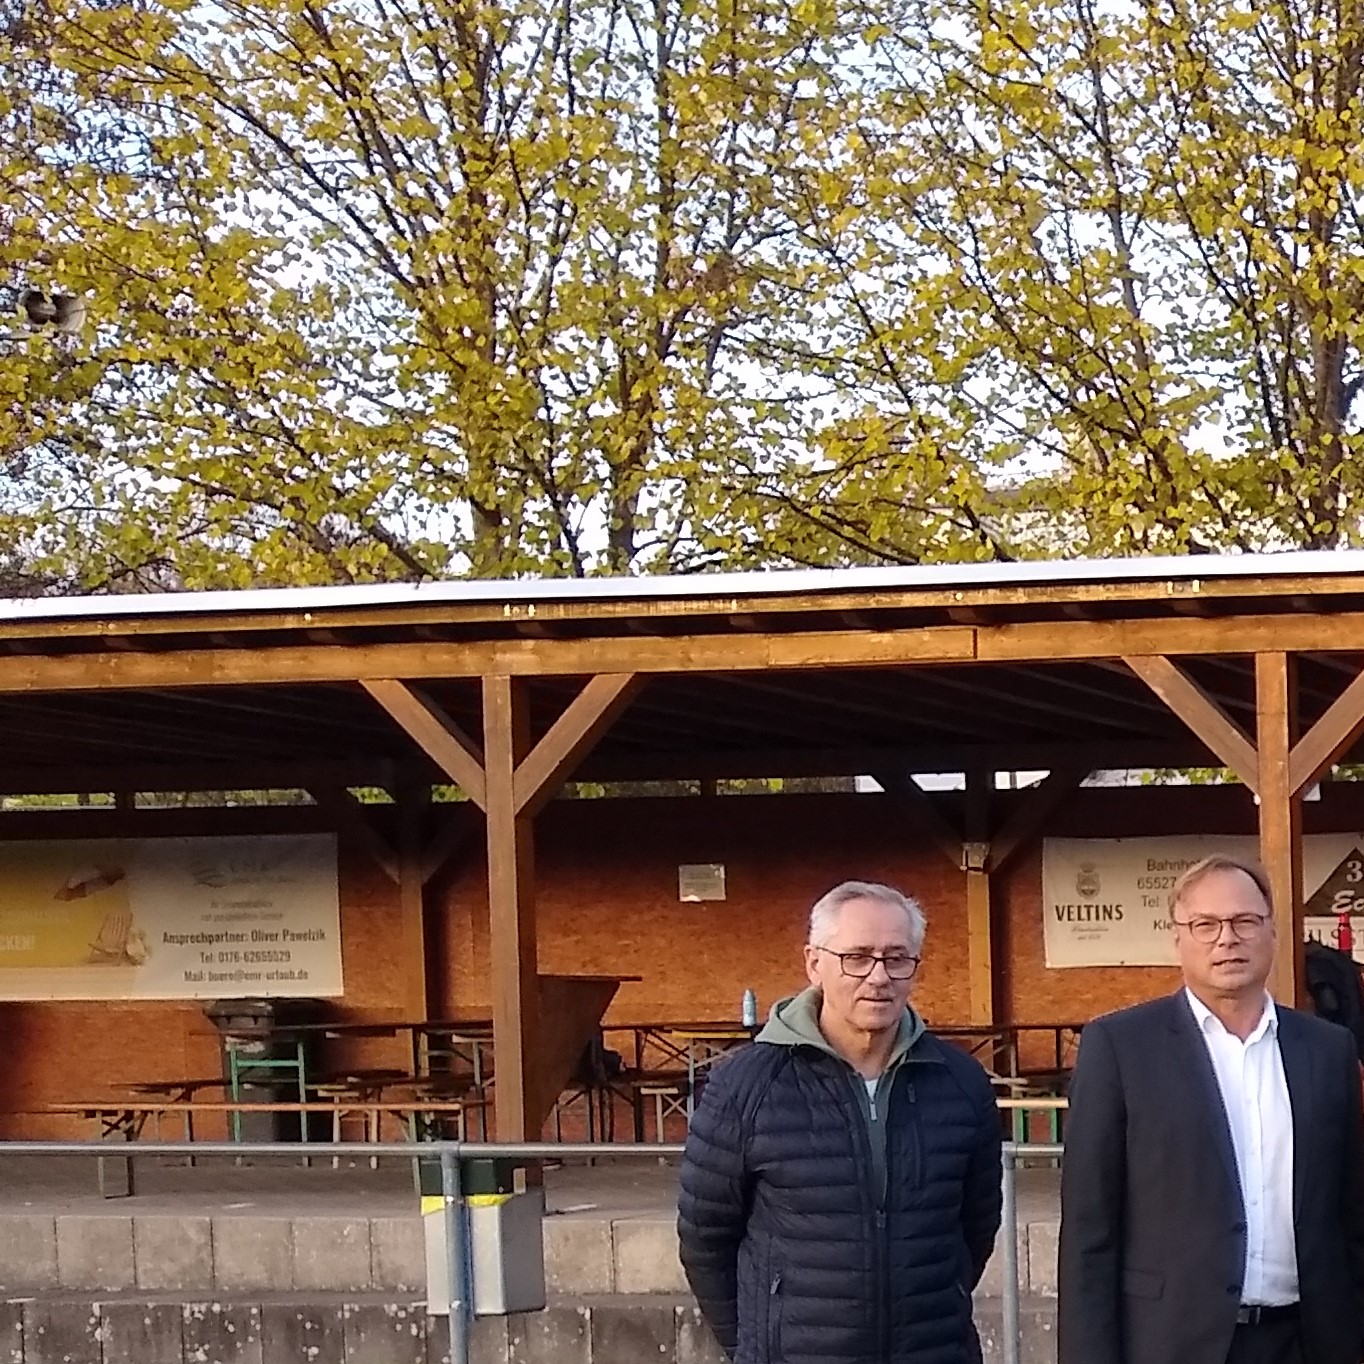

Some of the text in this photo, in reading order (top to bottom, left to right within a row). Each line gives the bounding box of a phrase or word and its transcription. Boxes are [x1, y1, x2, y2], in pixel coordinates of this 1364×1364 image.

[1346, 860, 1364, 883] 3
[1137, 876, 1177, 889] 65527
[1055, 904, 1124, 922] VELTINS
[251, 930, 279, 942] Oliver
